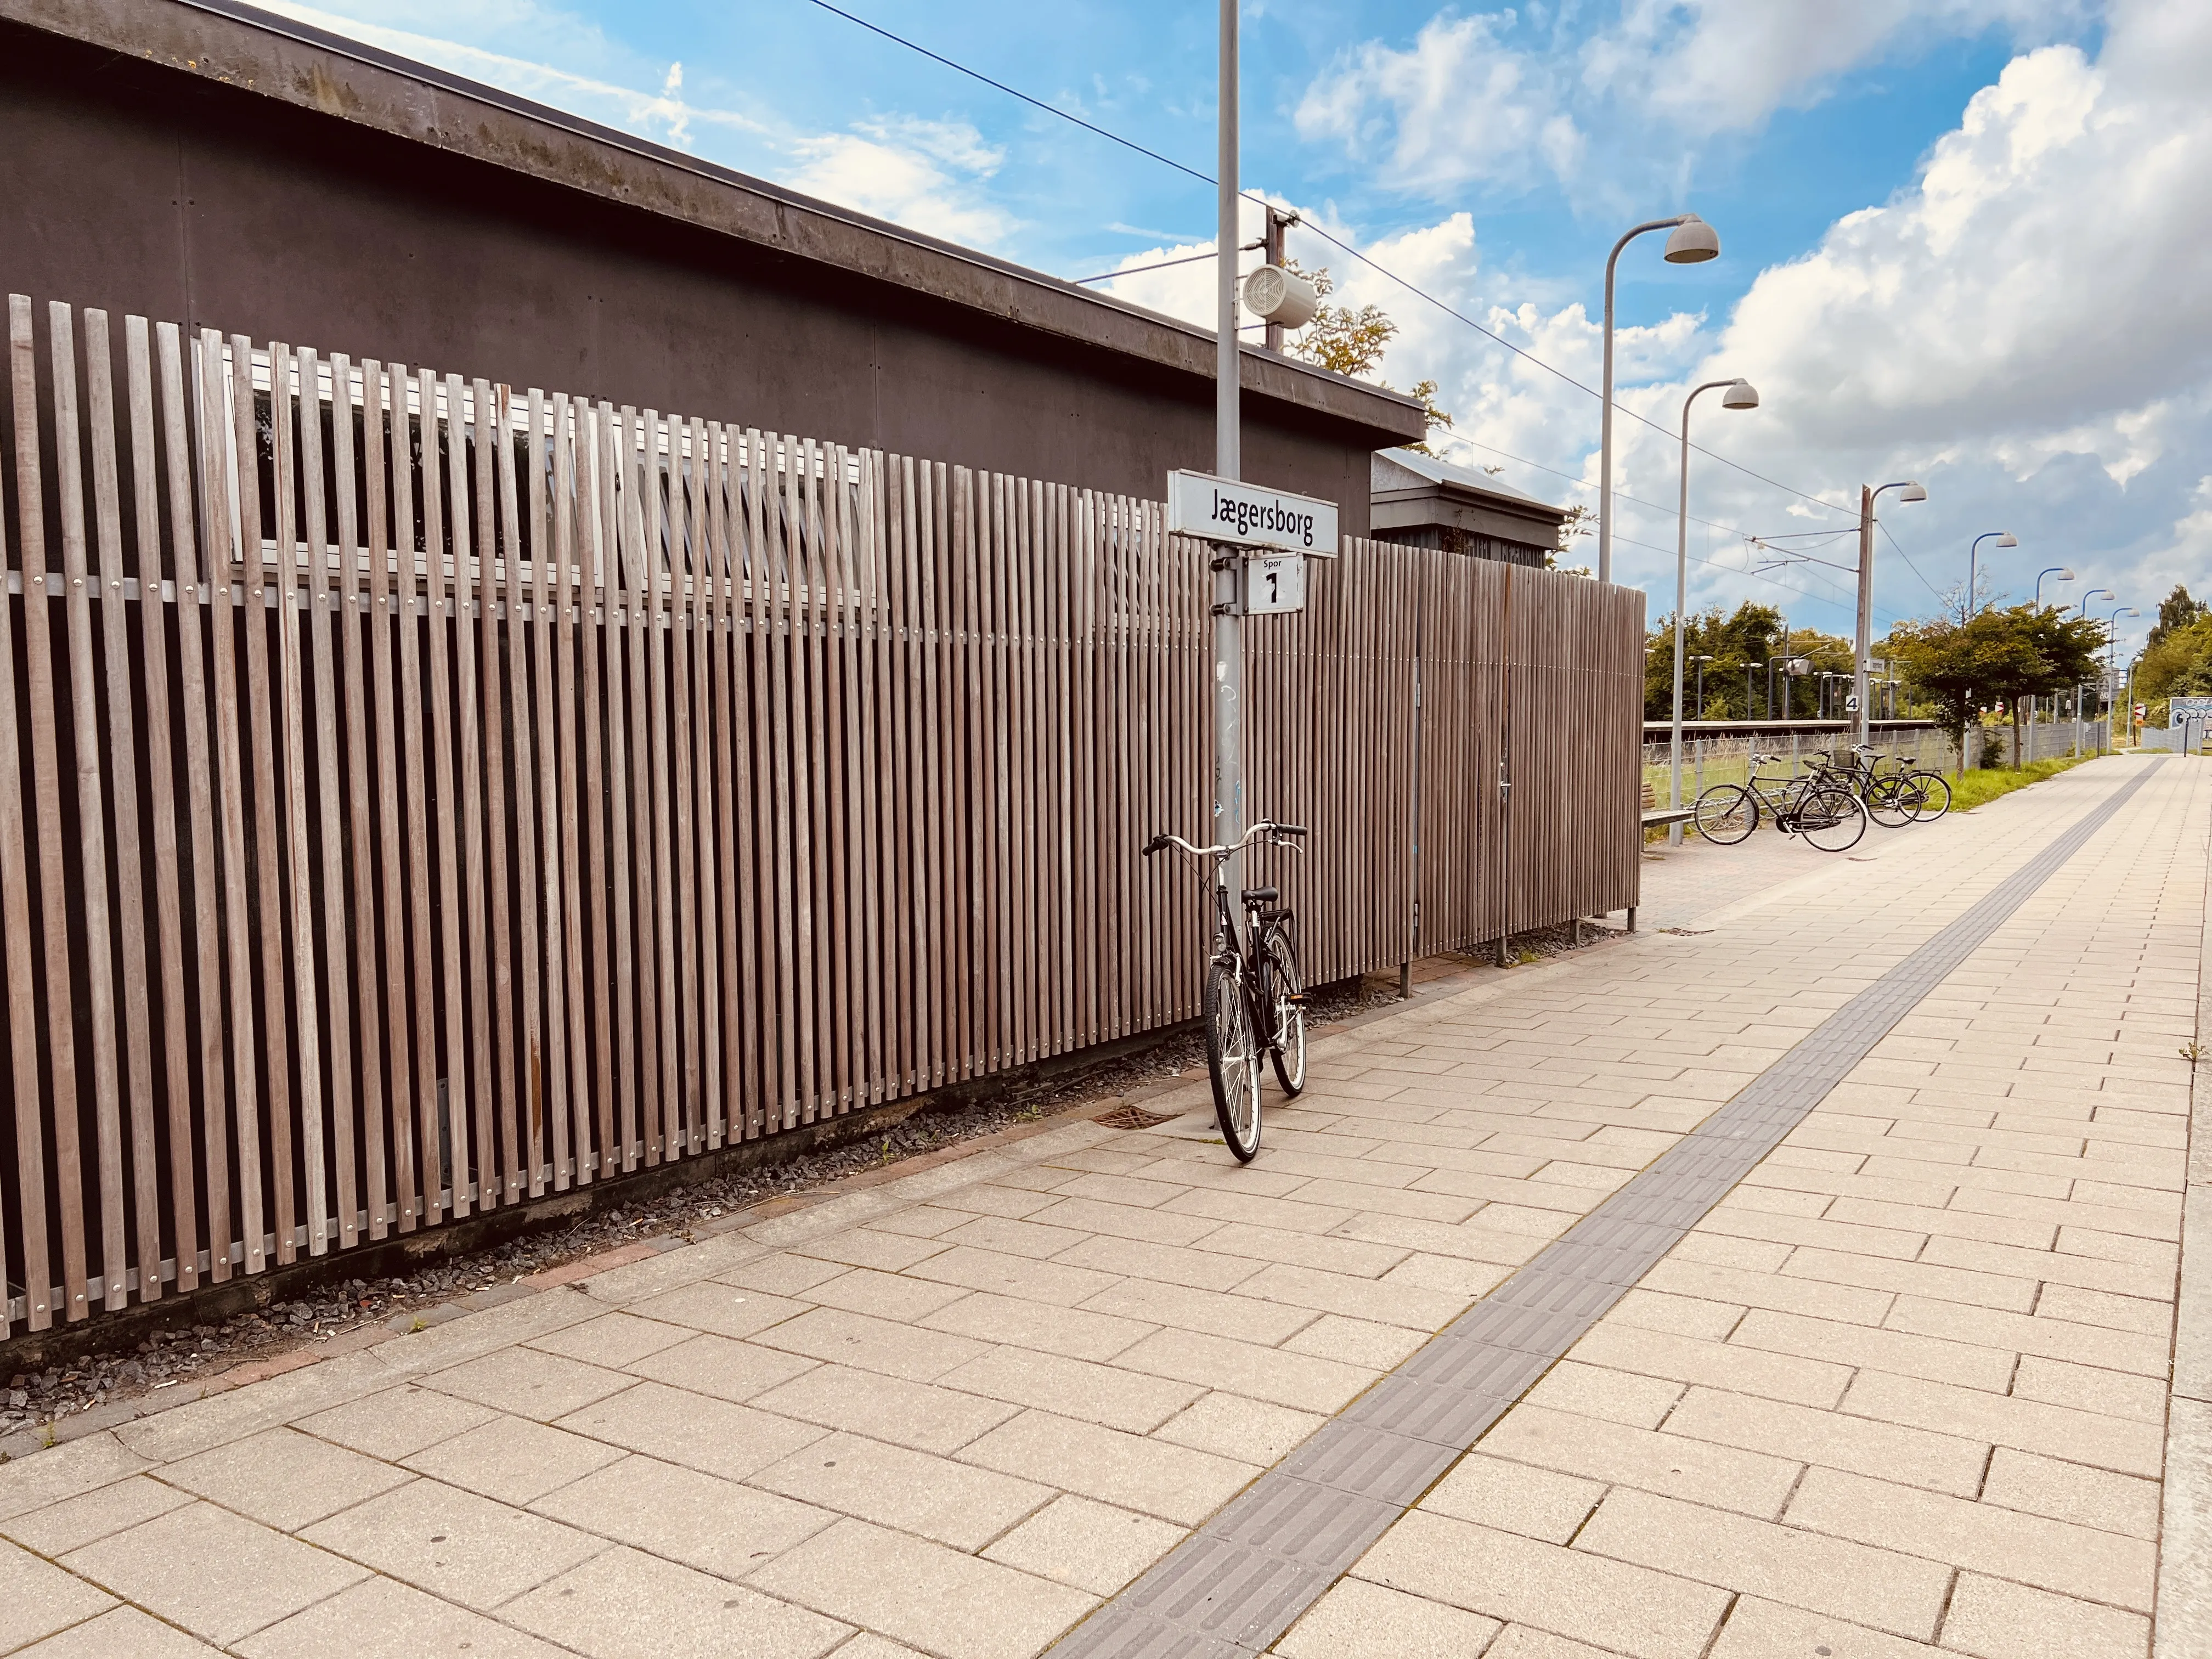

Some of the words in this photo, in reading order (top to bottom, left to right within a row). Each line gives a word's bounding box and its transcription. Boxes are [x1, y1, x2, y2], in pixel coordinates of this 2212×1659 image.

[1211, 488, 1313, 547] Jægersborg
[1263, 560, 1282, 570] Spor
[1266, 572, 1277, 603] 1
[1847, 697, 1858, 710] 4
